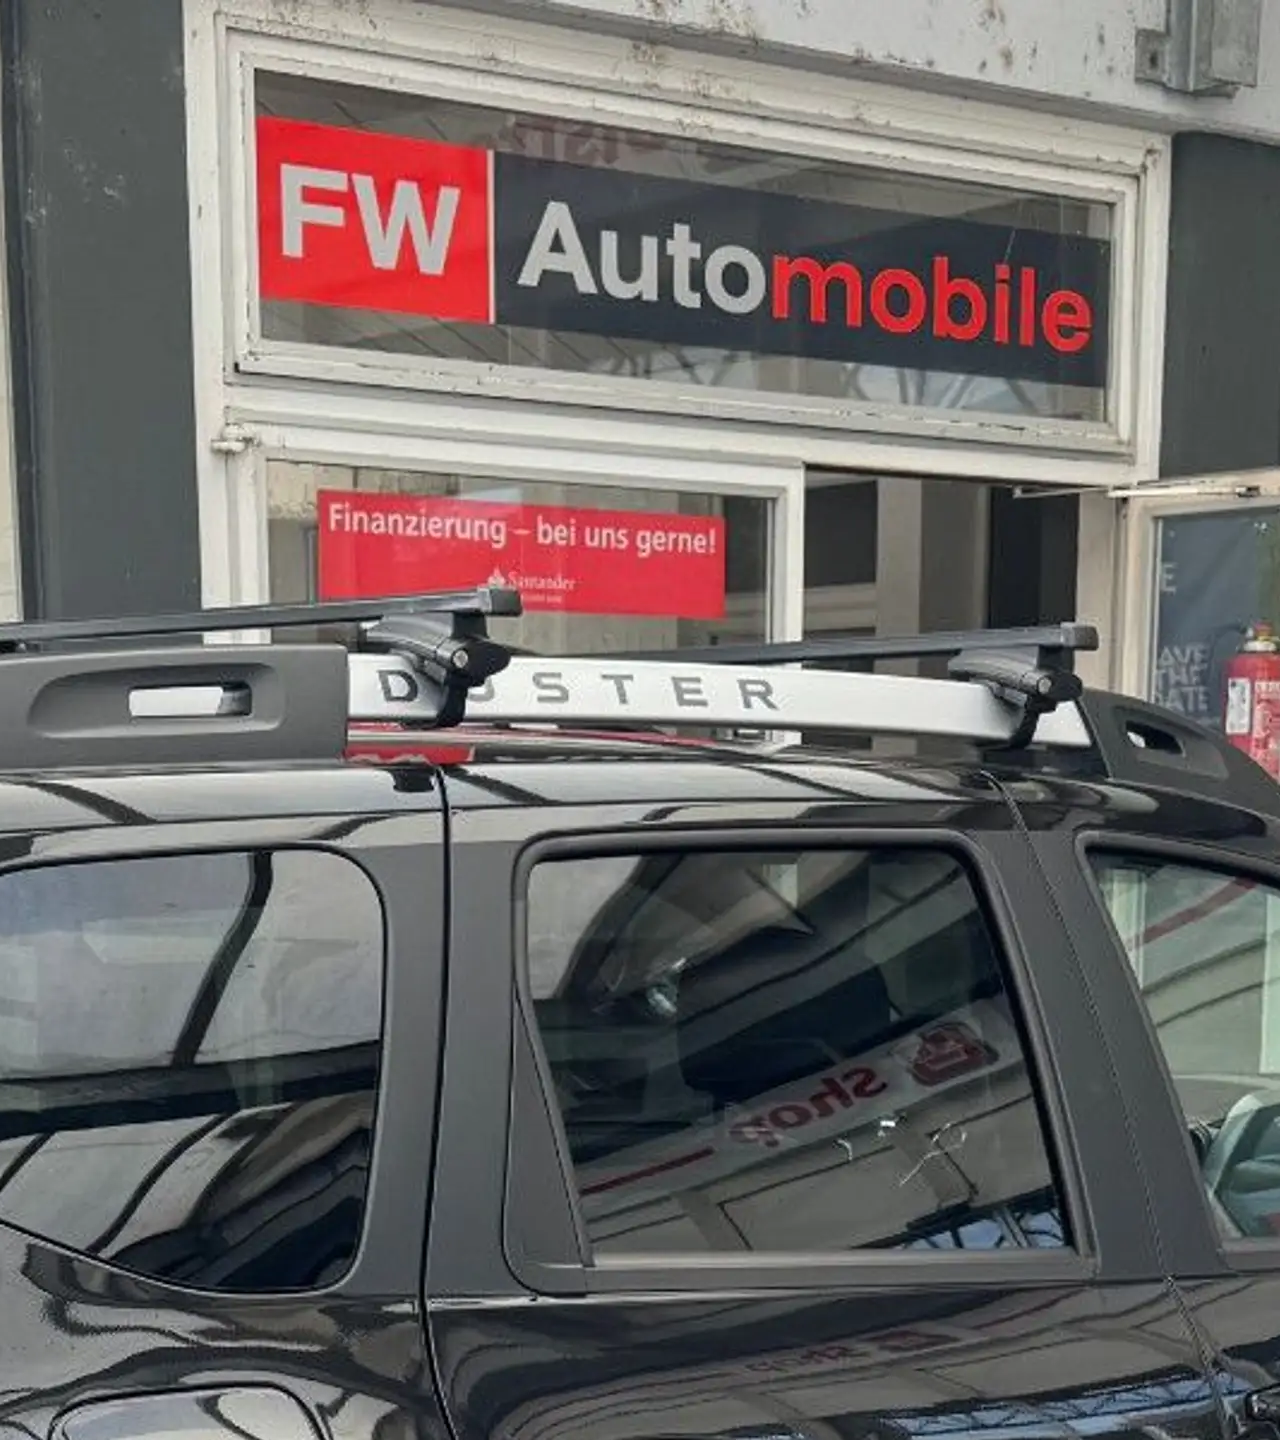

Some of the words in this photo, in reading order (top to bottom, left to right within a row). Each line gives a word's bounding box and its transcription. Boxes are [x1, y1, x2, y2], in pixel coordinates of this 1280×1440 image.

[279, 163, 461, 276] FW
[517, 200, 1093, 354] Automobile
[328, 502, 507, 549] Finanzierung
[536, 515, 577, 547] bei
[585, 526, 628, 550] uns
[635, 528, 718, 558] gerne!
[1158, 643, 1208, 668] AVE
